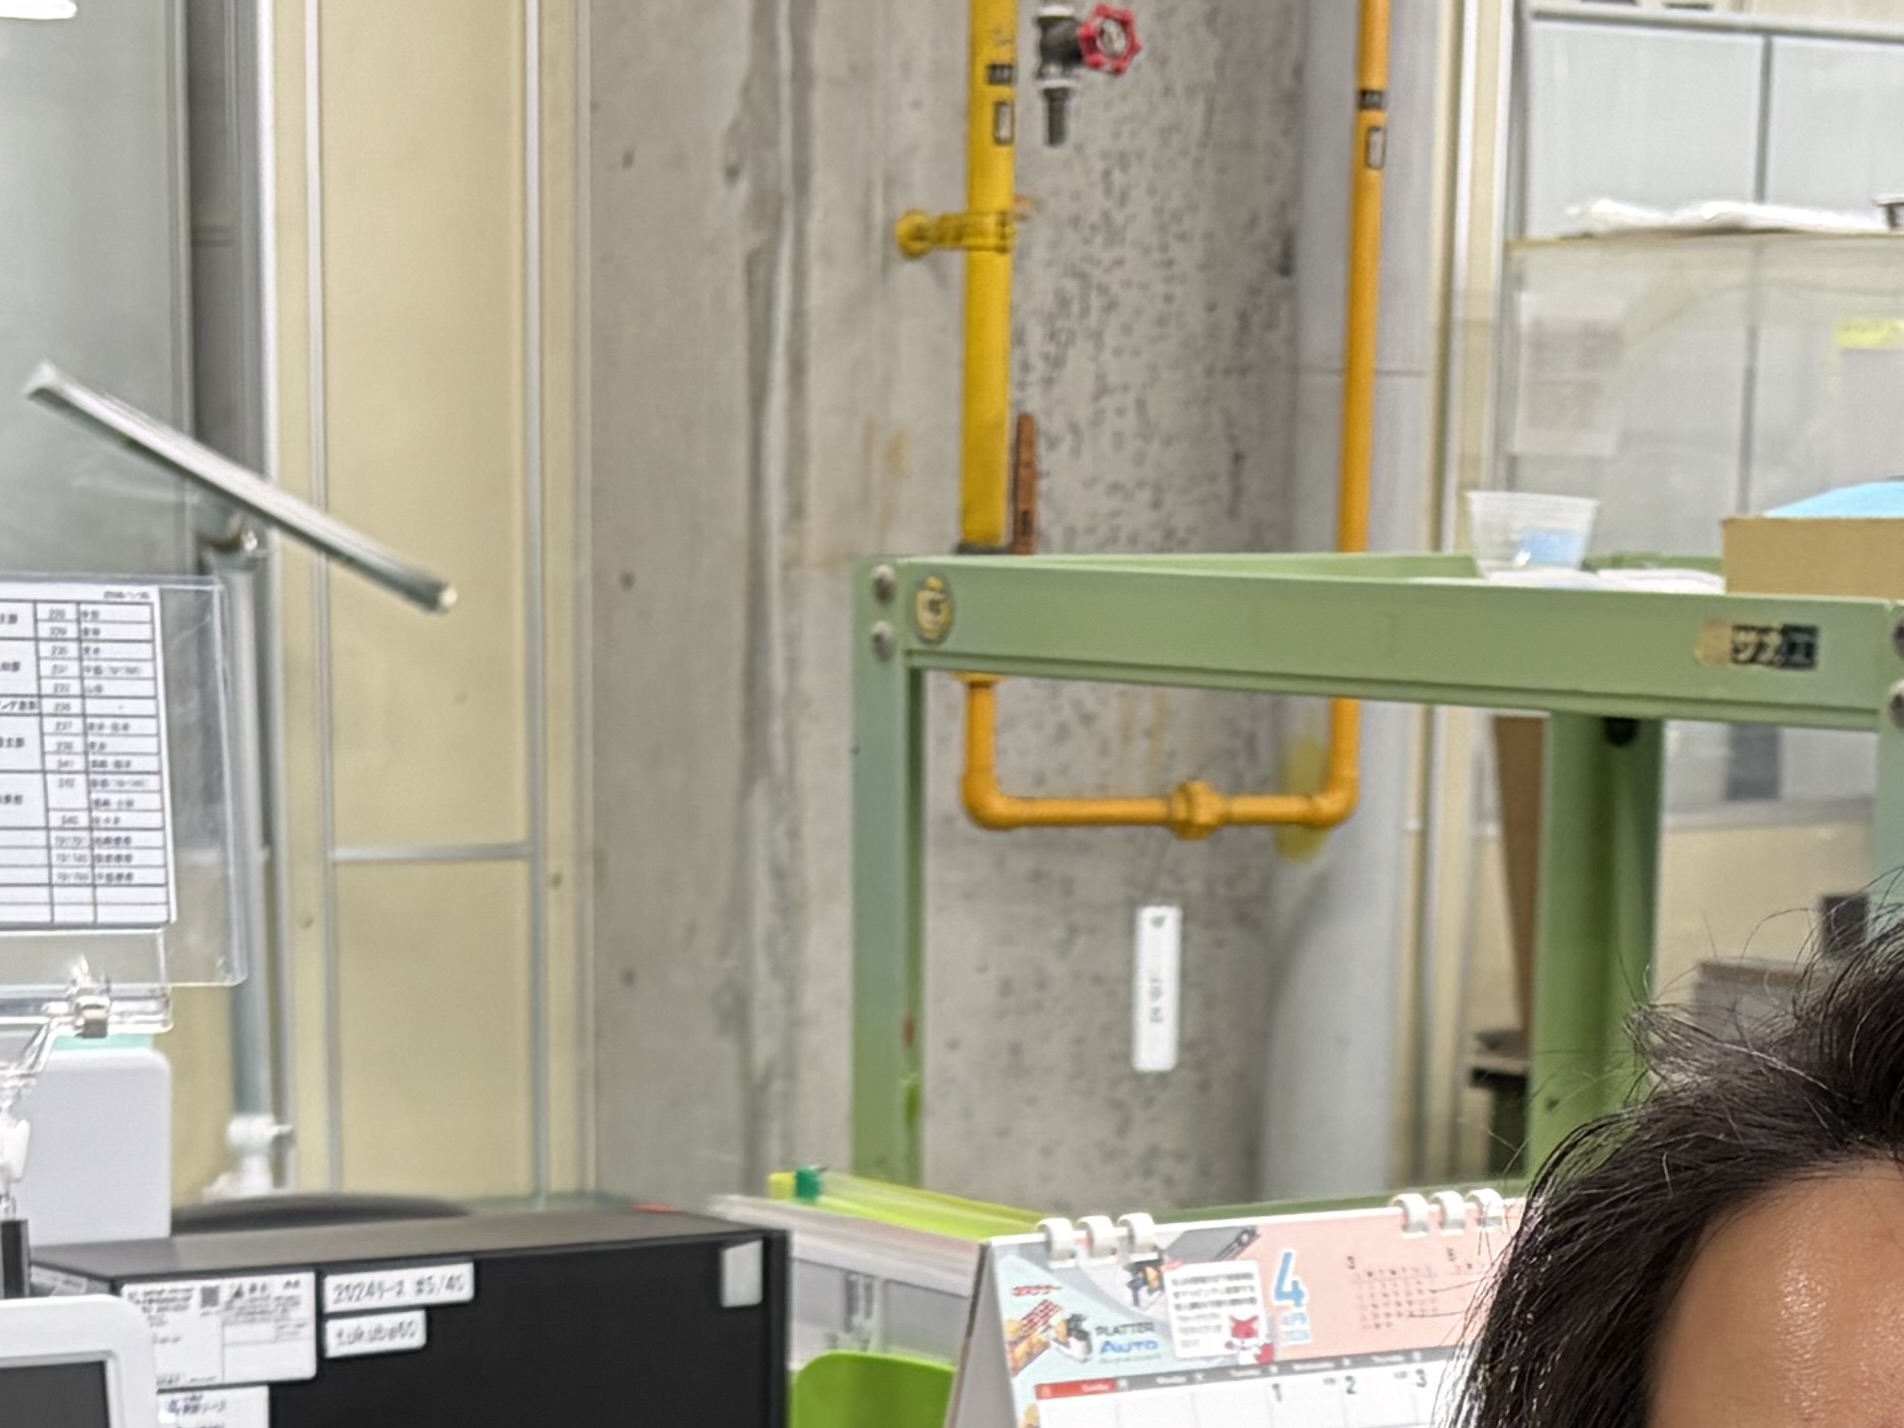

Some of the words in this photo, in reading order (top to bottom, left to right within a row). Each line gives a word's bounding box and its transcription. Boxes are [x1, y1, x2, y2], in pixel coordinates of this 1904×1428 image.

[1274, 1251, 1305, 1307] 4
[1271, 1383, 1283, 1402] 1
[1345, 1375, 1356, 1394] 2
[1415, 1368, 1428, 1388] 3
